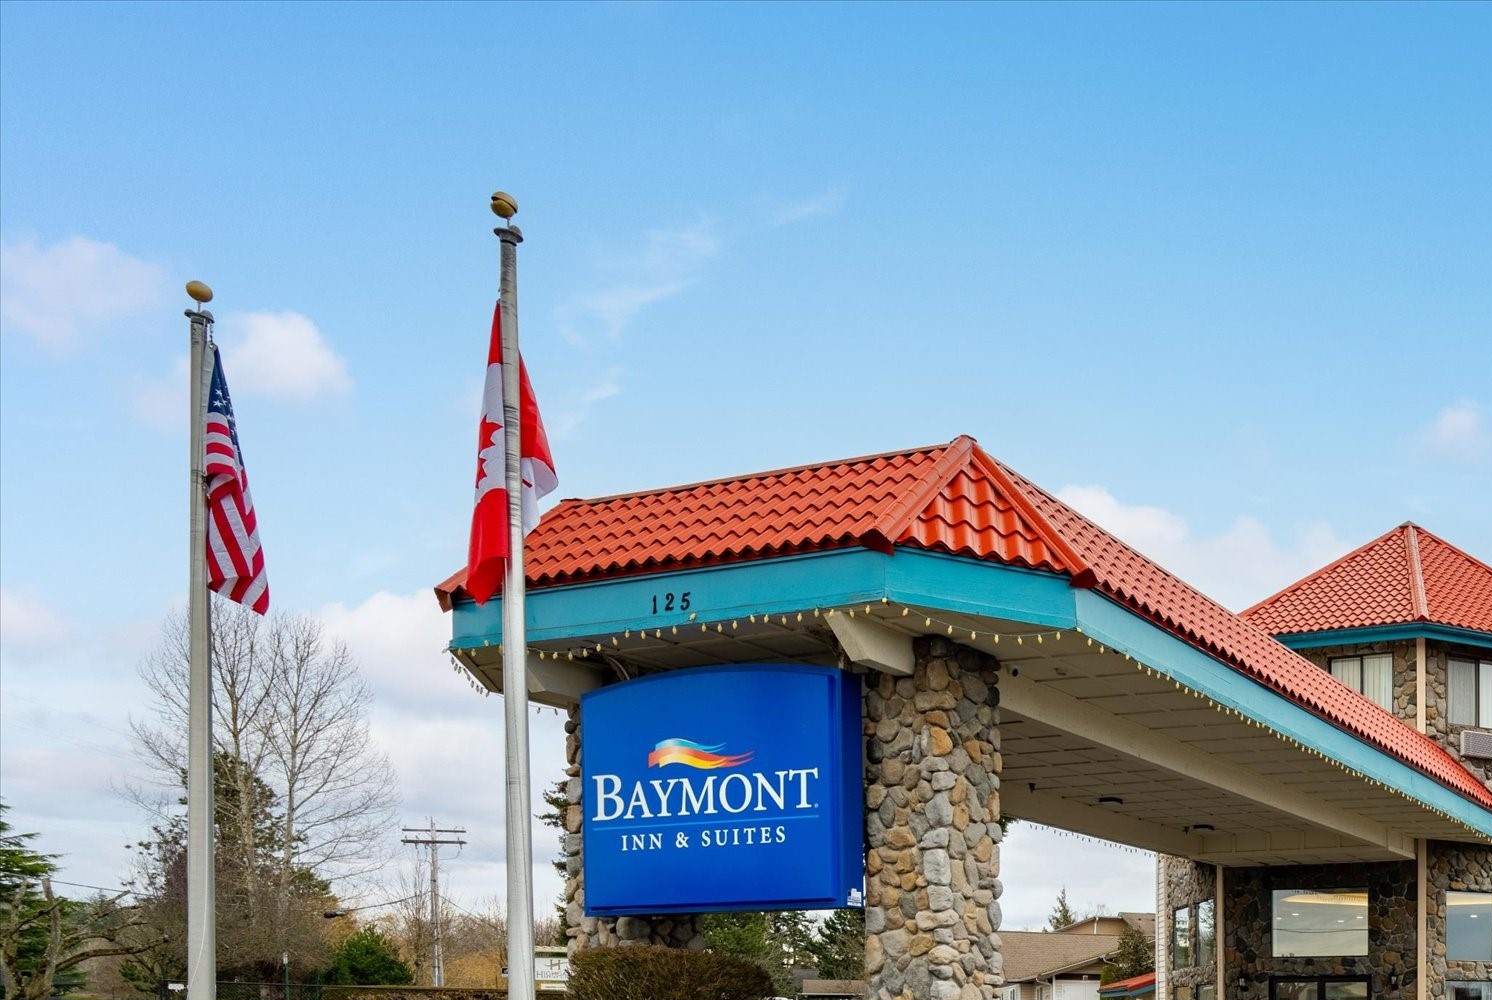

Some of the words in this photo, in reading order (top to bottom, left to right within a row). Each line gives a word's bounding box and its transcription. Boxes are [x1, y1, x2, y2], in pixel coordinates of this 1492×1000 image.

[652, 592, 691, 615] 125
[592, 767, 818, 821] BAYMONT
[621, 833, 663, 851] INN
[675, 831, 690, 848] &
[701, 826, 786, 847] SUITES
